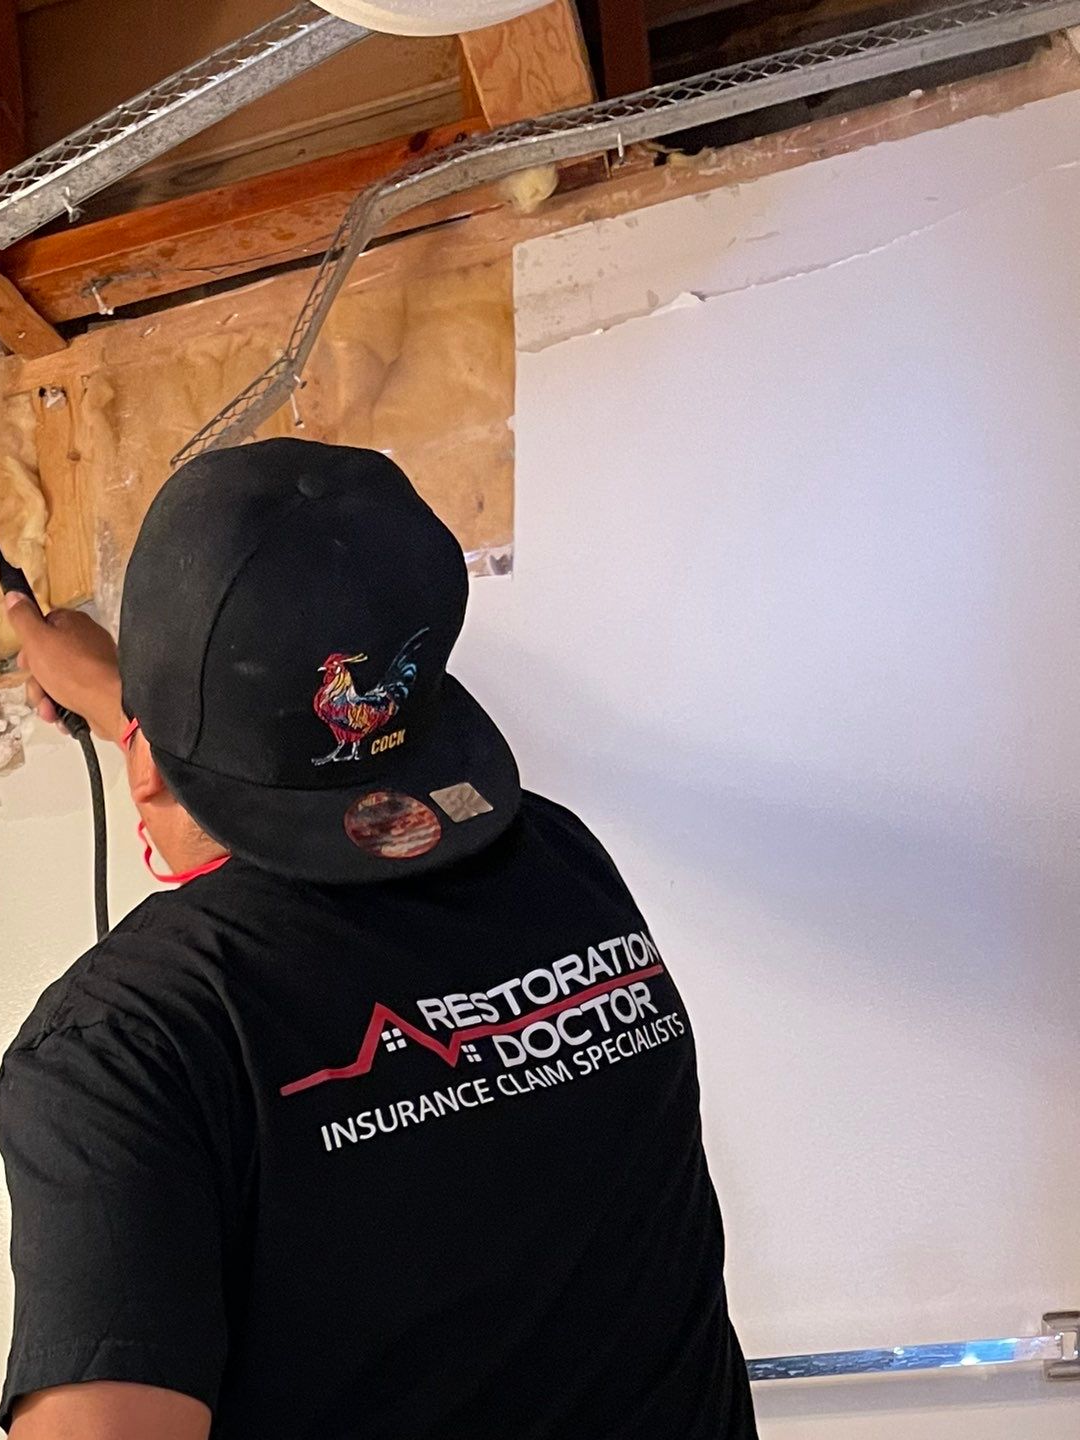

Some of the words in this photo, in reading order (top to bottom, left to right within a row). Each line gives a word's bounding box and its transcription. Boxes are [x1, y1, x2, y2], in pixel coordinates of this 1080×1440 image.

[370, 728, 407, 756] COCK
[416, 930, 661, 1032] RESTORATION
[491, 981, 659, 1068] DOCTOR
[320, 1078, 495, 1151] INSURANCE
[497, 1059, 573, 1097] CLAIM
[574, 1012, 686, 1077] SPECIALISTS
